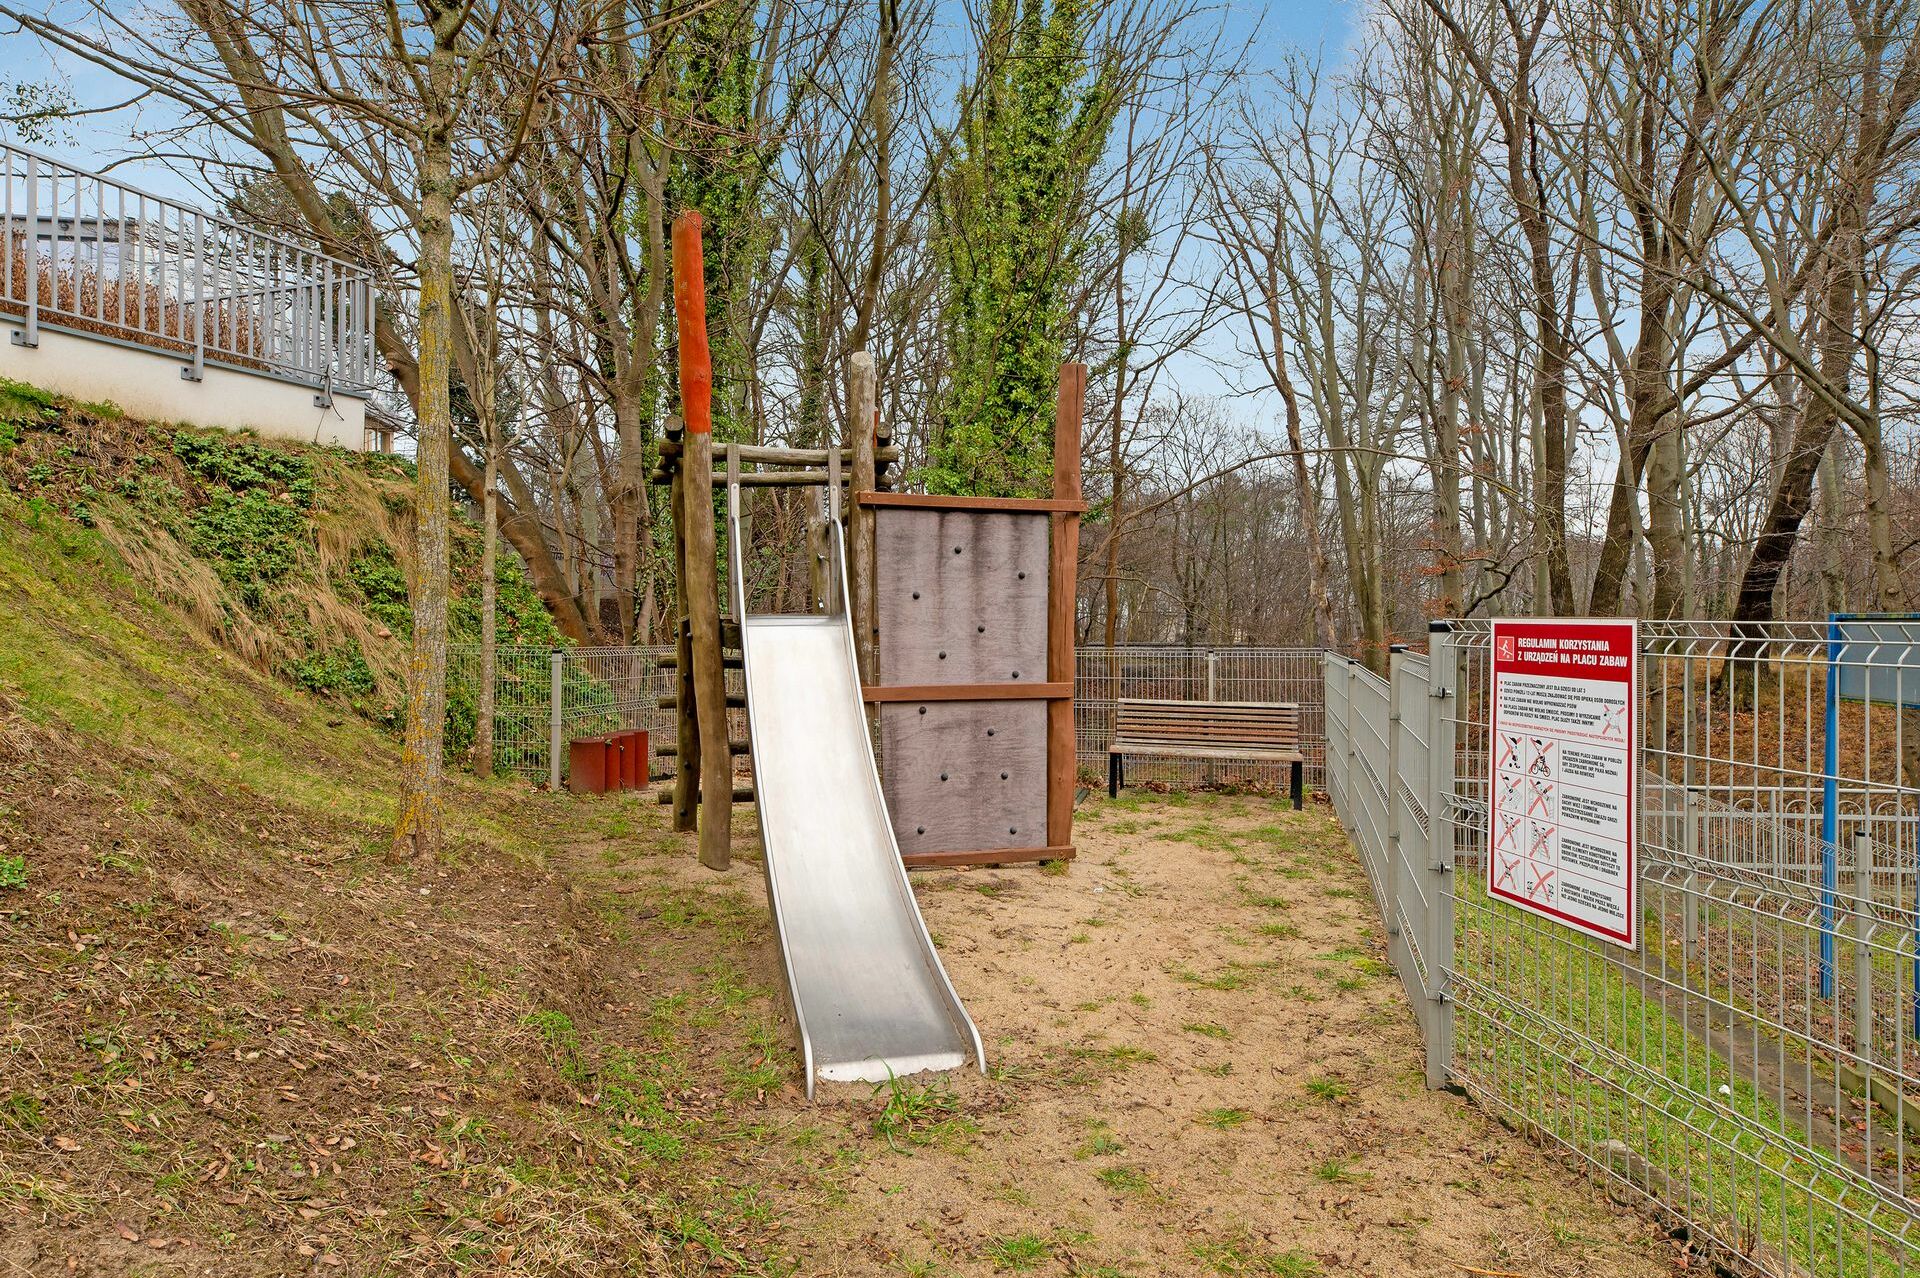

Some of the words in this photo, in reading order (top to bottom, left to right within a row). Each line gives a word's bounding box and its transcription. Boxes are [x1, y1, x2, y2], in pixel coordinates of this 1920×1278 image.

[1518, 638, 1557, 649] REGULAMIN
[1559, 640, 1609, 651] KORZYSTANIA
[1518, 652, 1522, 660] Z
[1524, 650, 1558, 664] URZĄDZEŃ
[1561, 655, 1570, 663] NA
[1573, 656, 1596, 665] PLACU
[1600, 656, 1627, 667] ZABAW
